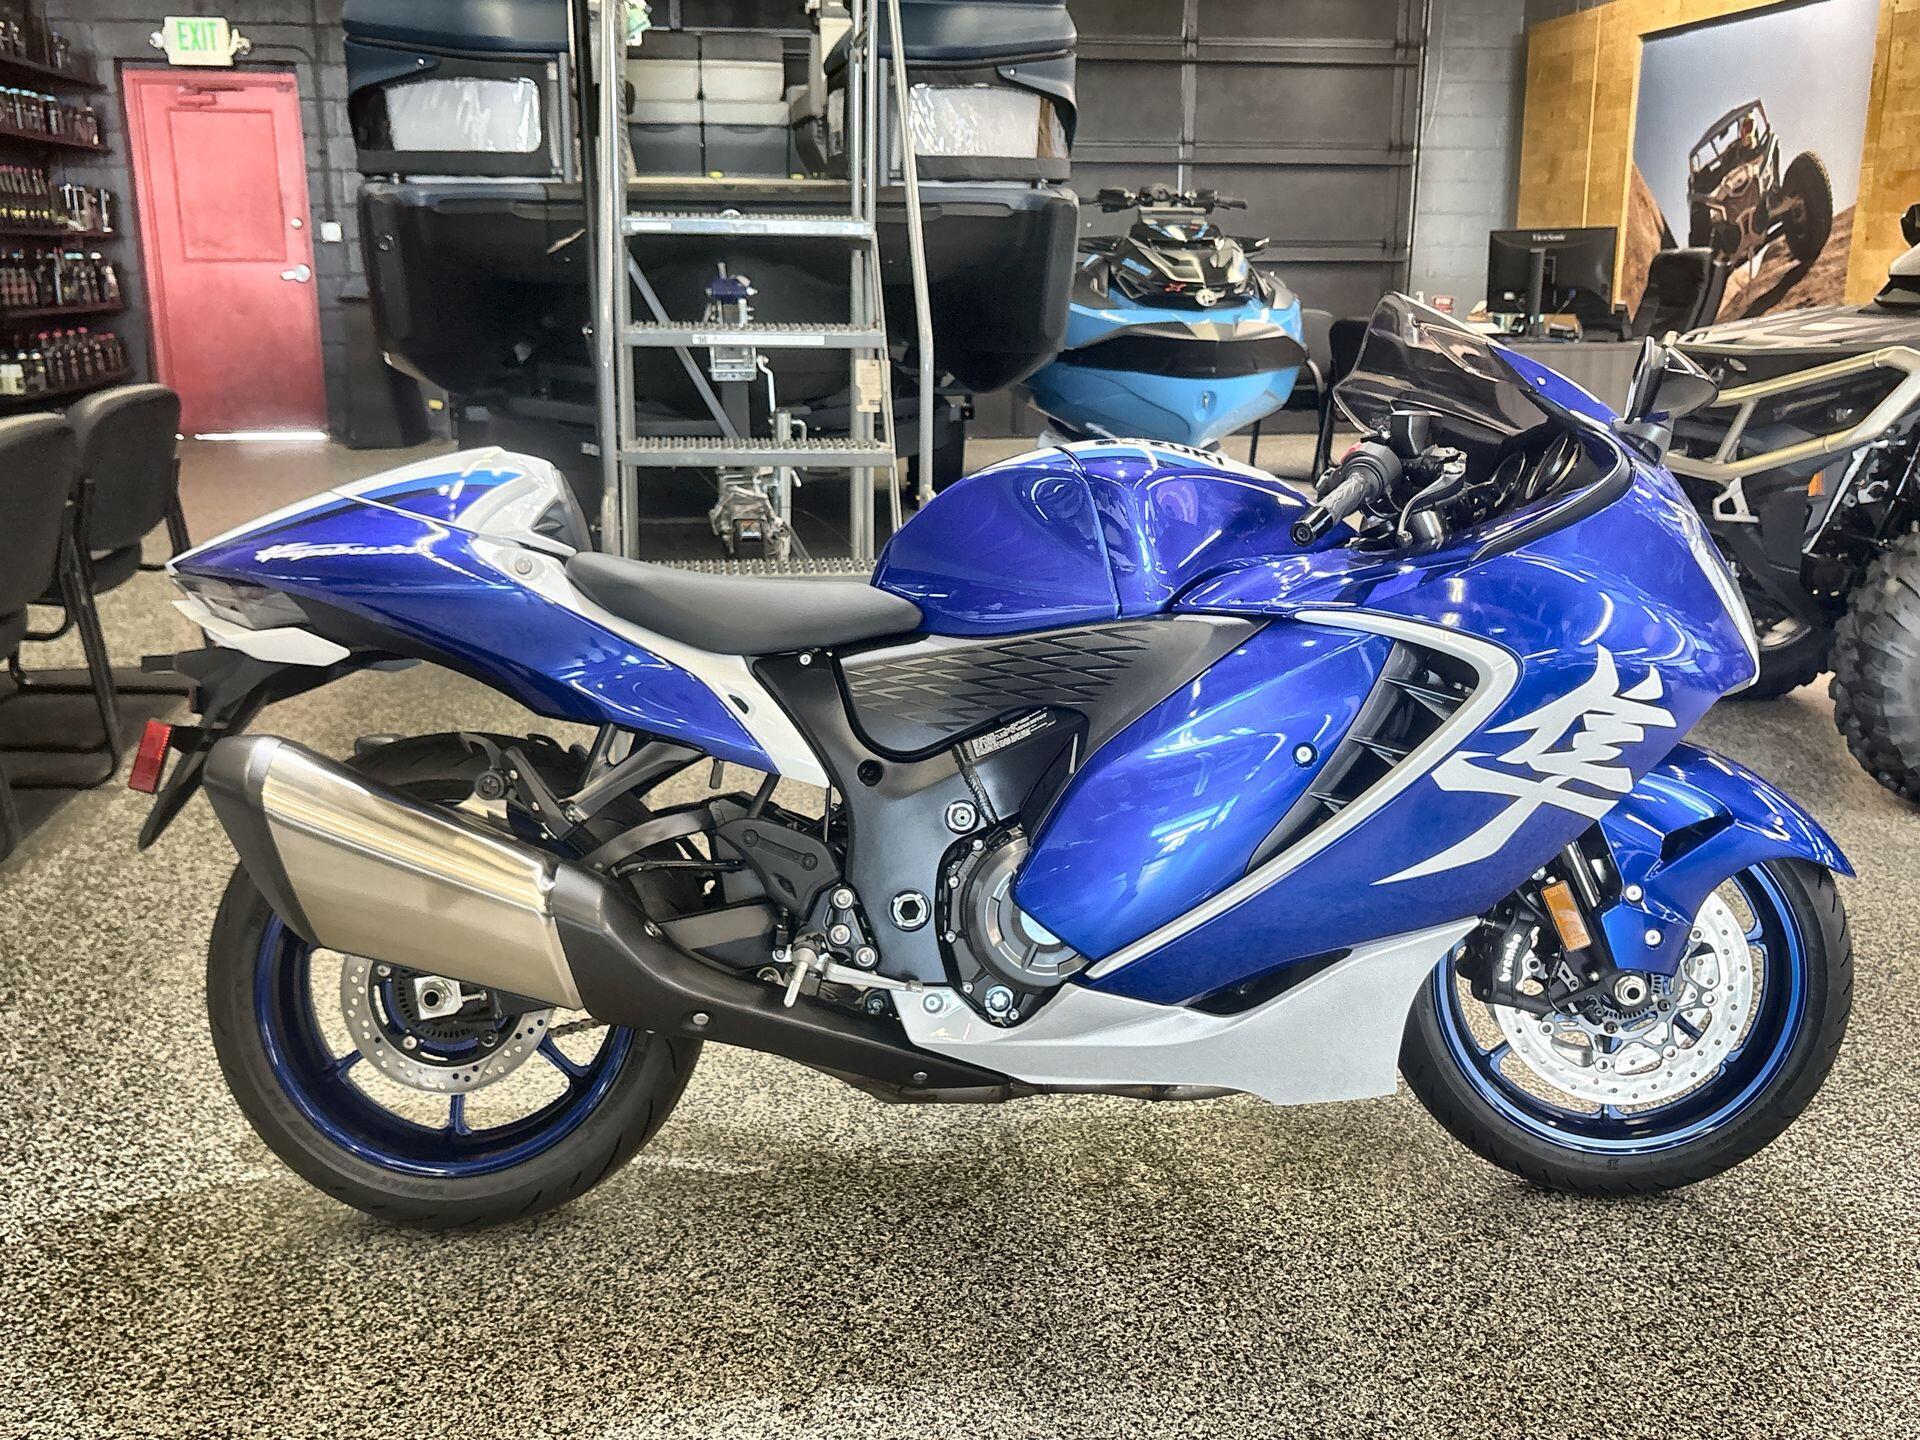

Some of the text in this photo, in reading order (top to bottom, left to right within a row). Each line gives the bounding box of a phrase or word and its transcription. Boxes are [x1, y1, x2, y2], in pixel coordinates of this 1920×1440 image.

[177, 21, 217, 51] EXIT
[1095, 439, 1224, 466] SZUKI
[1498, 933, 1522, 982] brembo
